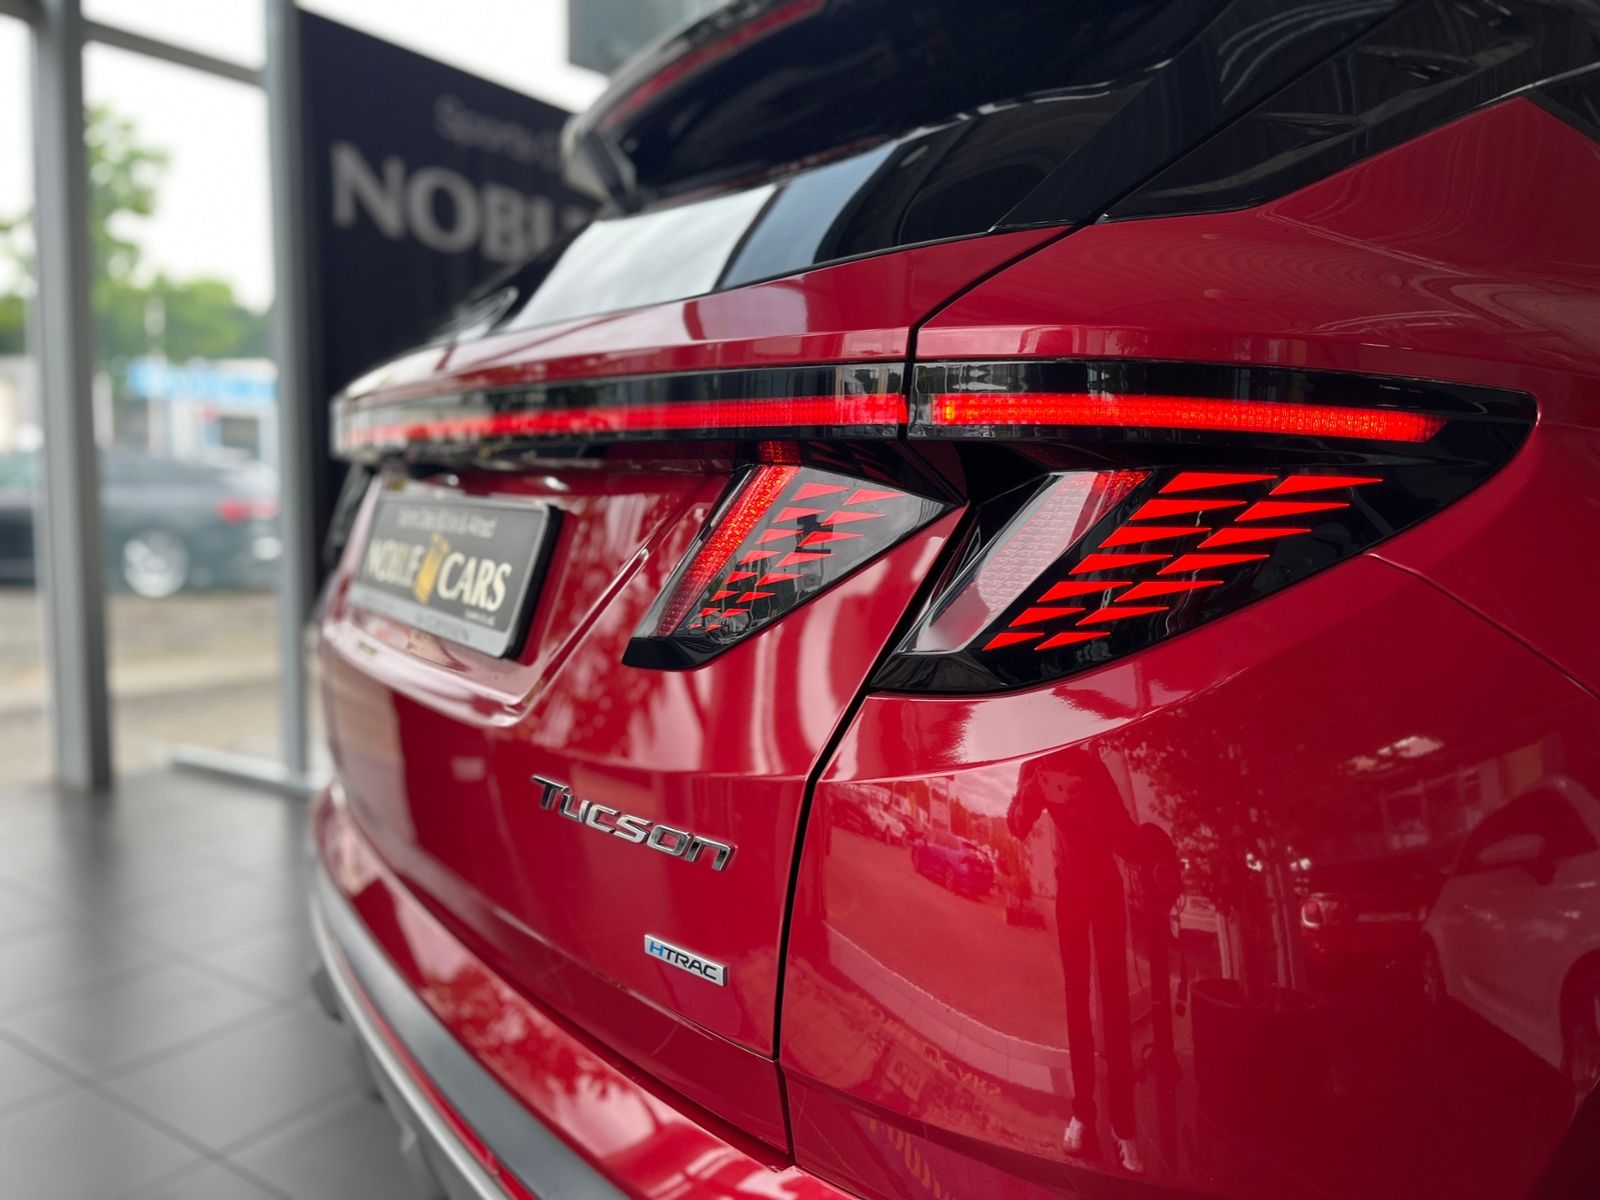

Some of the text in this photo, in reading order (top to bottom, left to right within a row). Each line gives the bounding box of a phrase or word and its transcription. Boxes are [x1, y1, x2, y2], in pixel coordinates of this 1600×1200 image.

[331, 140, 592, 266] NOBL
[437, 552, 512, 611] CARS
[649, 940, 718, 981] HTRAC
